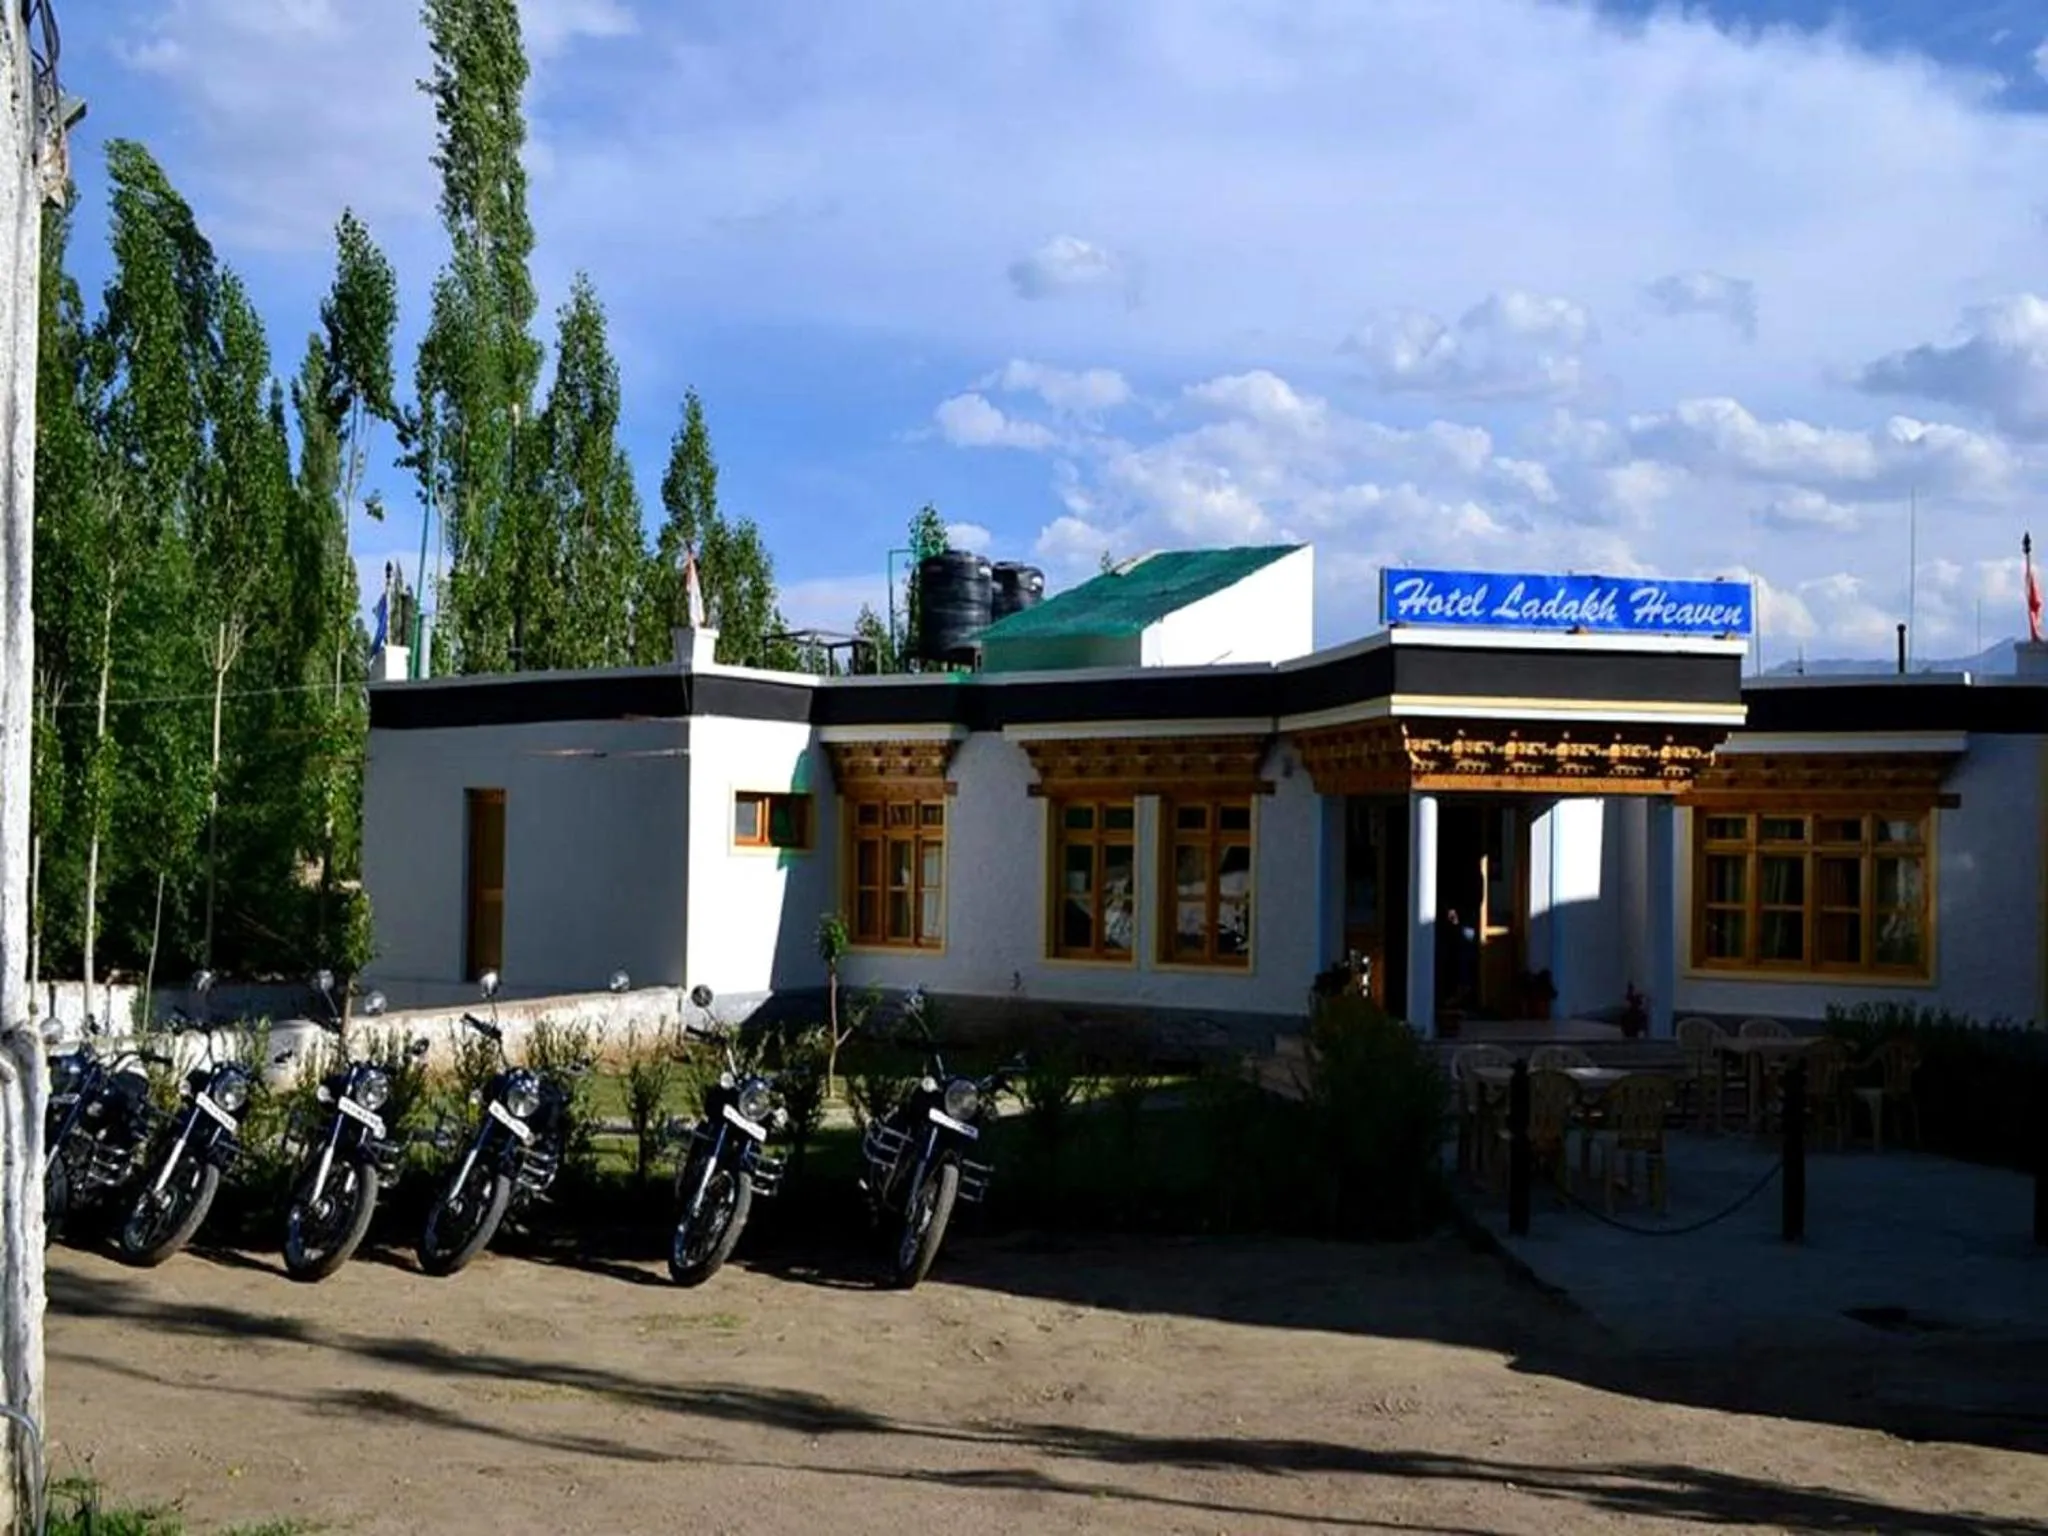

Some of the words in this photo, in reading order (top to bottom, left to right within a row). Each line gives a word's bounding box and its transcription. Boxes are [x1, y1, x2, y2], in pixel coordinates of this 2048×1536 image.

[1393, 577, 1488, 617] Hotel
[1491, 581, 1619, 622] Ladakh
[1628, 586, 1744, 625] Heaven
